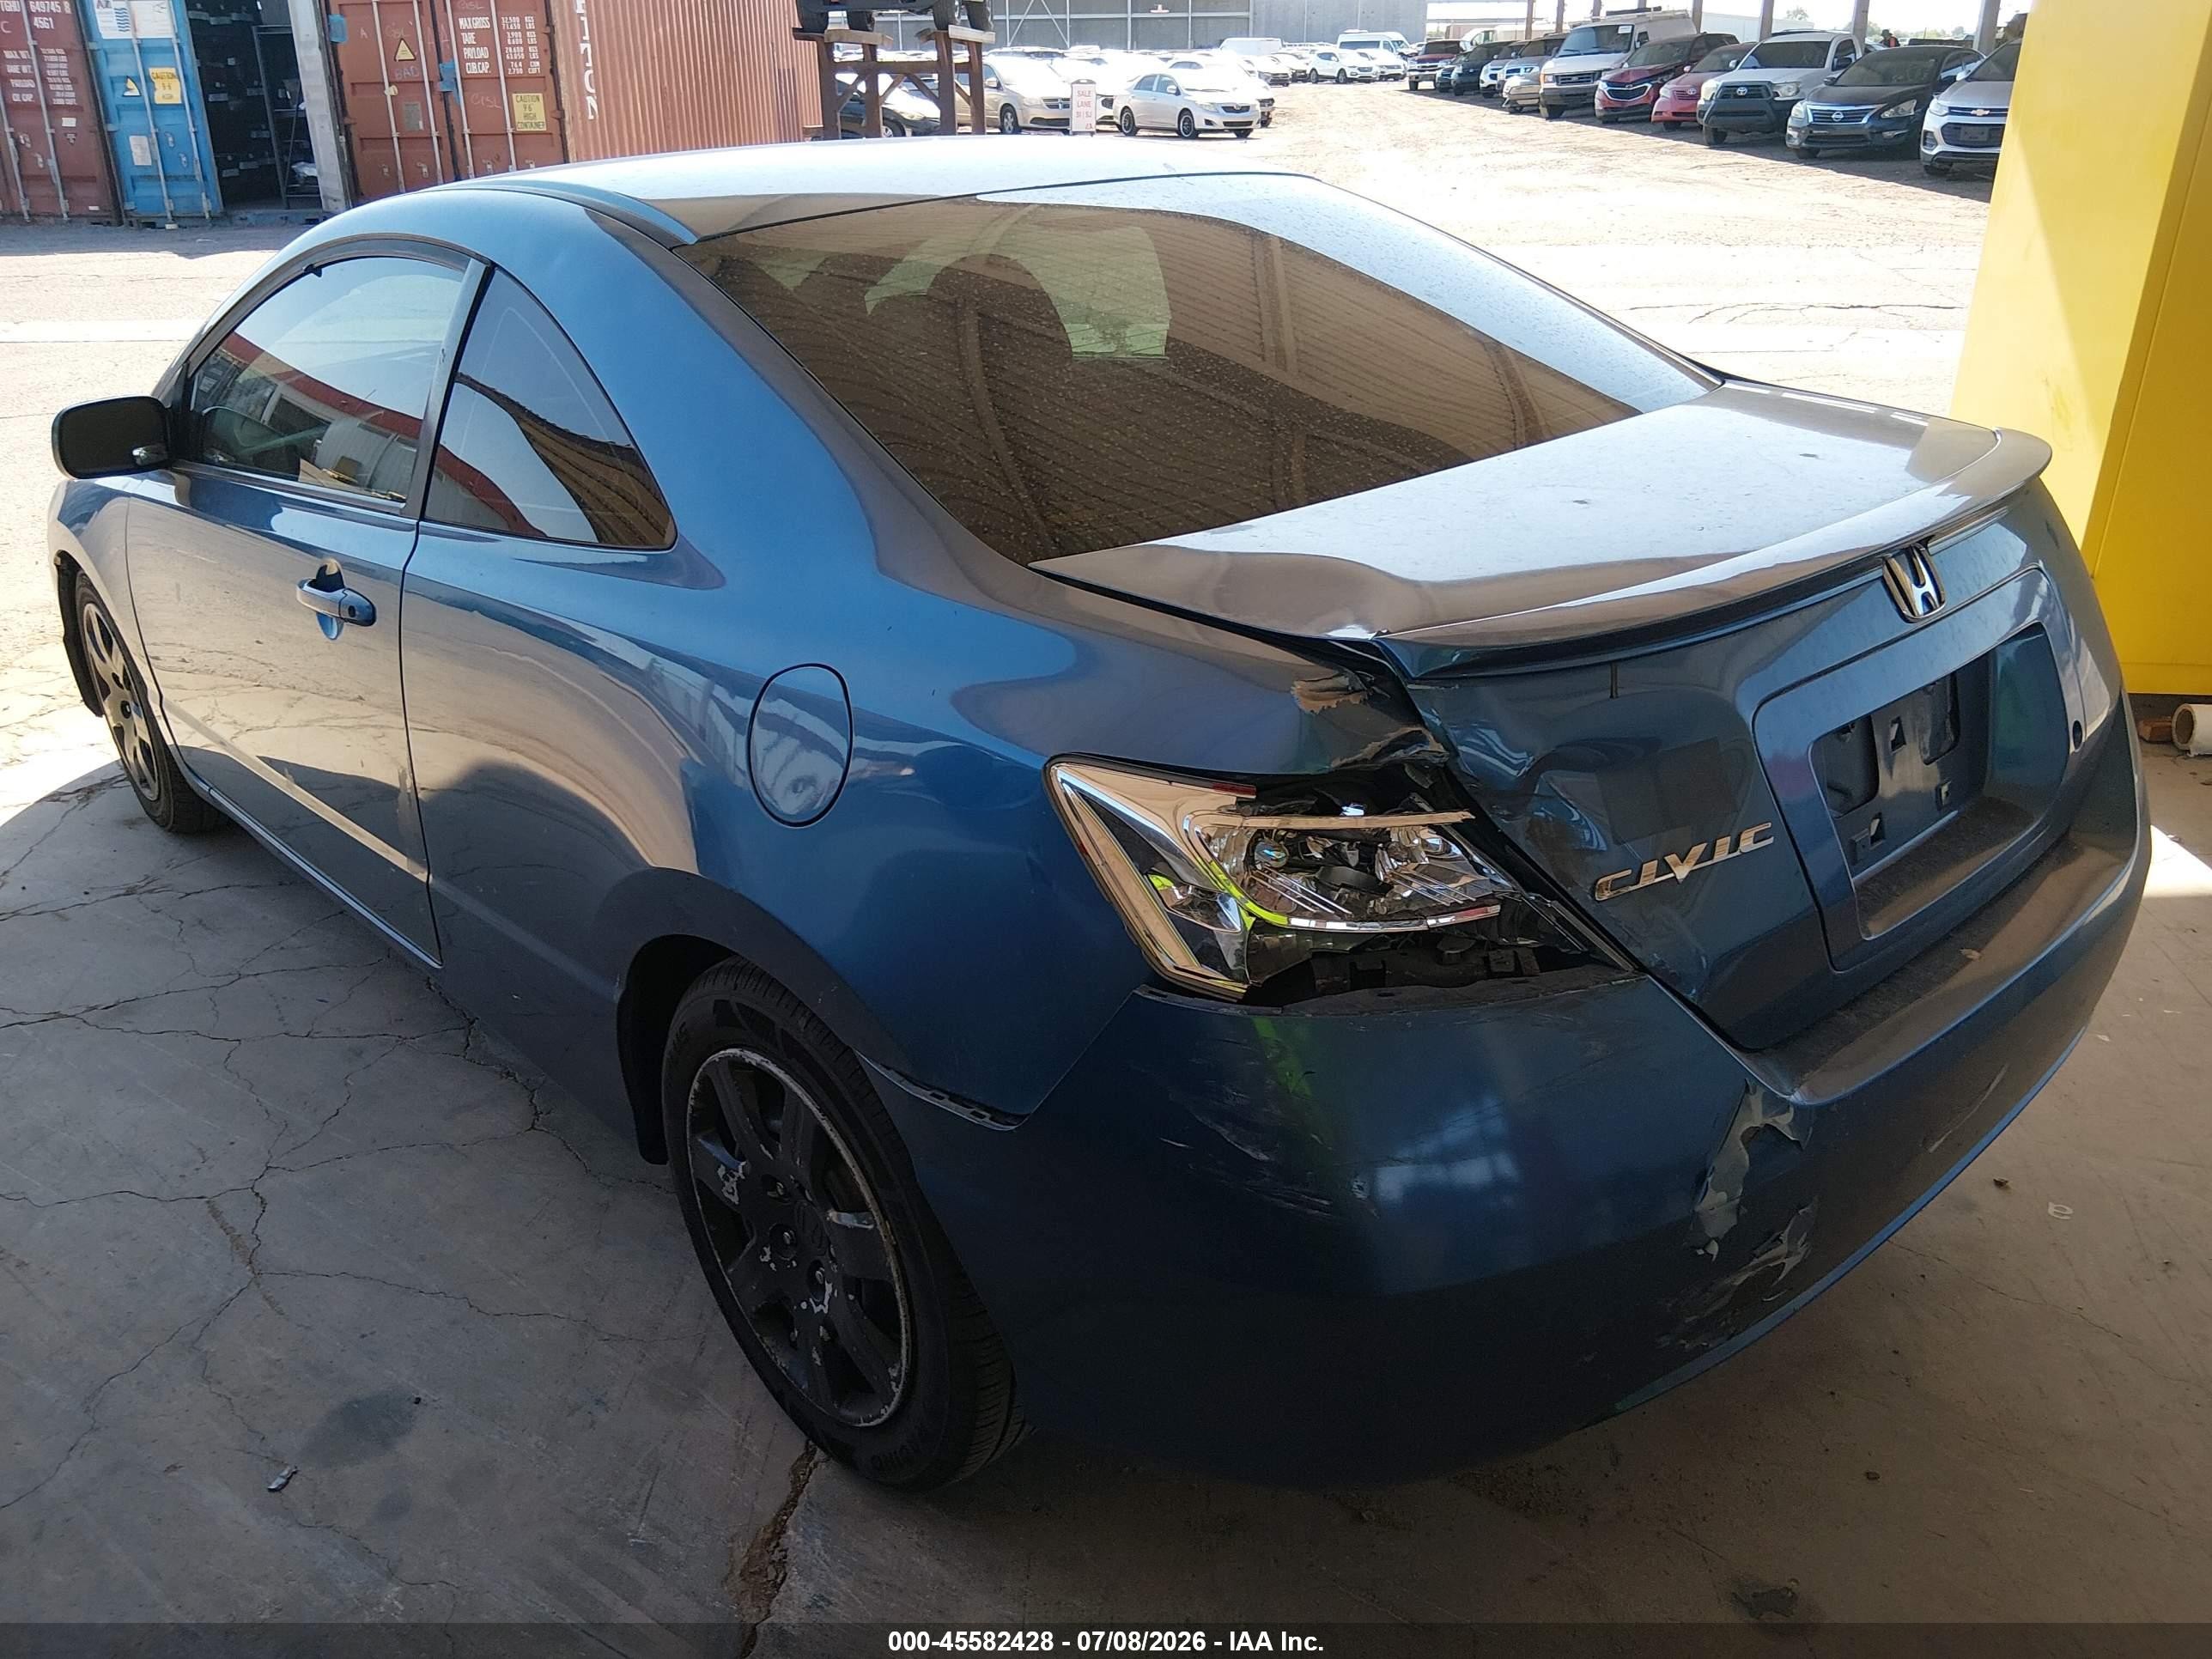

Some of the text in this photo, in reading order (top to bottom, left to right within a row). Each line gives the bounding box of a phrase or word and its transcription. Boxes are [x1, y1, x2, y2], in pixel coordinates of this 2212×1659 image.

[464, 46, 489, 59] PAYLOAD
[515, 94, 541, 103] CAUTION
[1595, 822, 1774, 902] CIVIC
